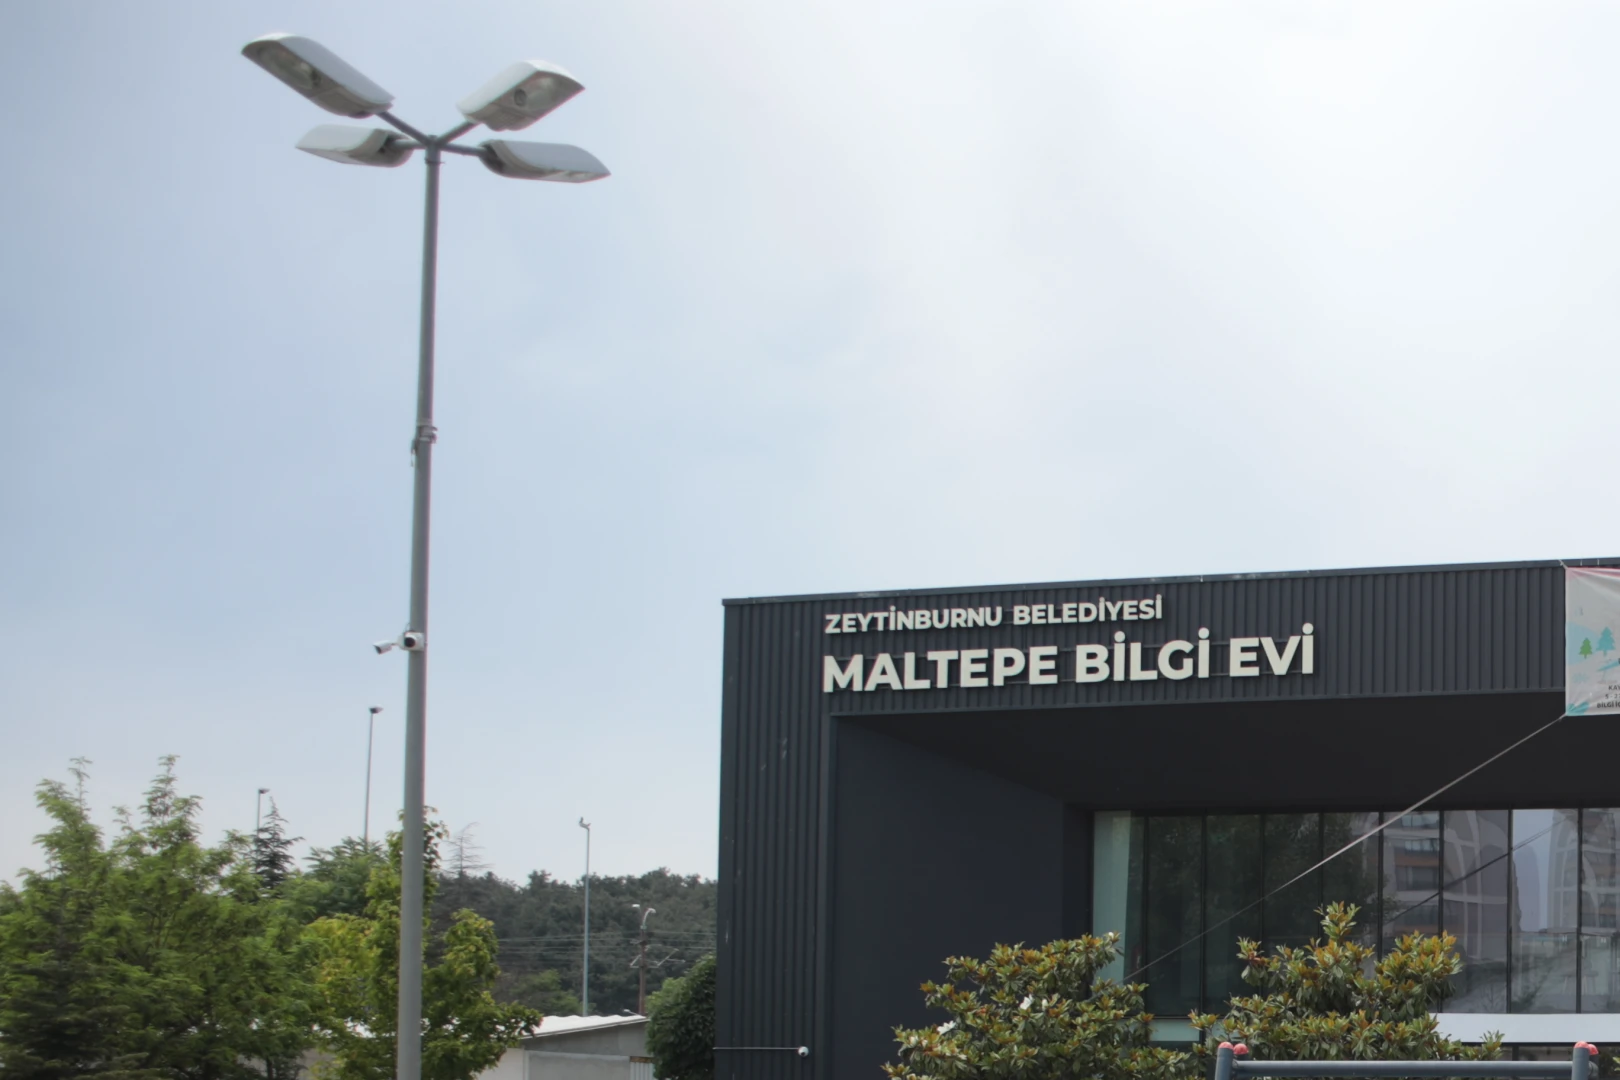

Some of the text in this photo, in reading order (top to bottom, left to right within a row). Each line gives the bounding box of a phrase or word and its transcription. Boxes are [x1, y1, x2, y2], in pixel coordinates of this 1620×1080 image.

[825, 594, 1163, 634] ZEYTİNBURNU BELEDİYESİ
[823, 622, 1315, 693] MALTEPE BİLGİ EVİ
